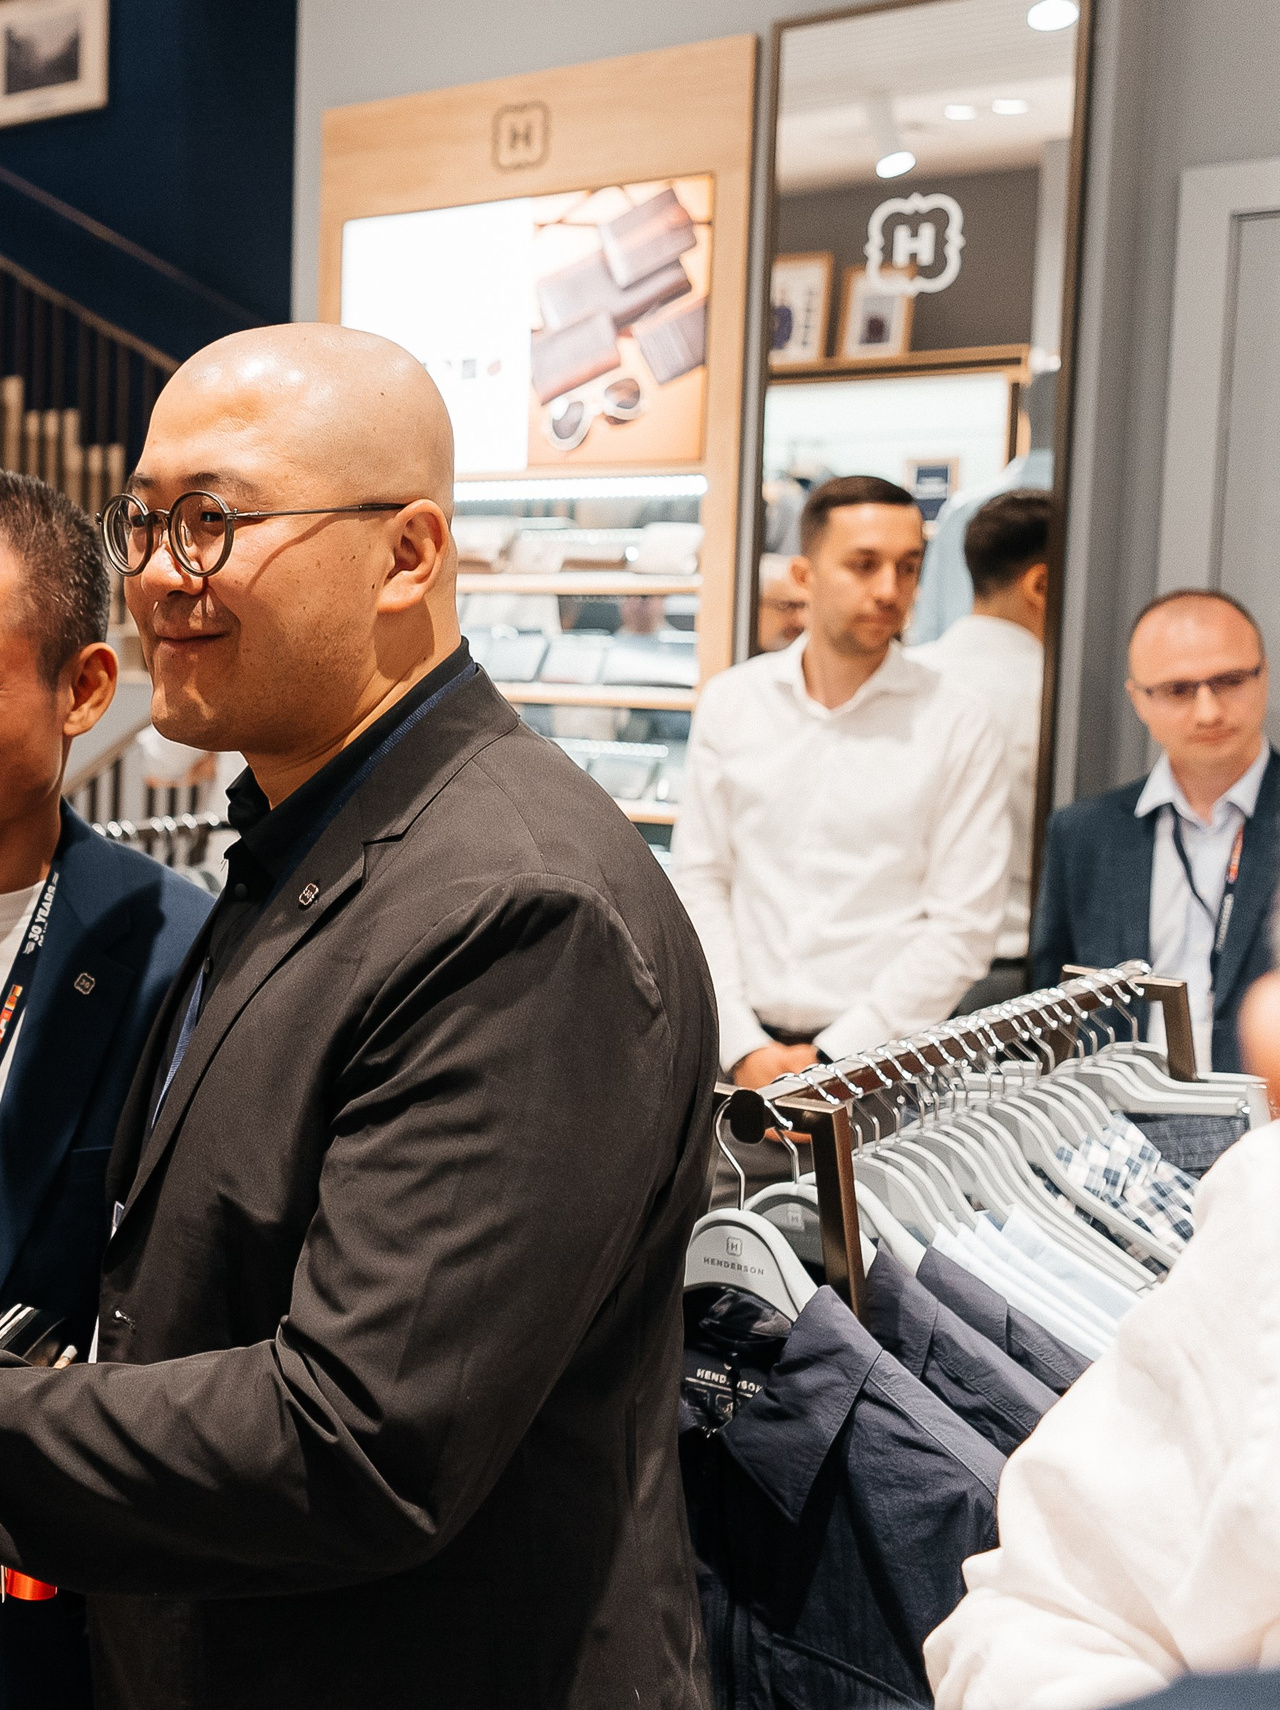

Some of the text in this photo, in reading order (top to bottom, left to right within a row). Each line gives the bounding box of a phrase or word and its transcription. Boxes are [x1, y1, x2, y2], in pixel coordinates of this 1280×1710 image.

[892, 221, 935, 268] H
[28, 924, 42, 942] 30
[35, 885, 56, 923] YEARS
[703, 1256, 764, 1275] HENDERSON
[696, 1368, 763, 1393] HENDSO
